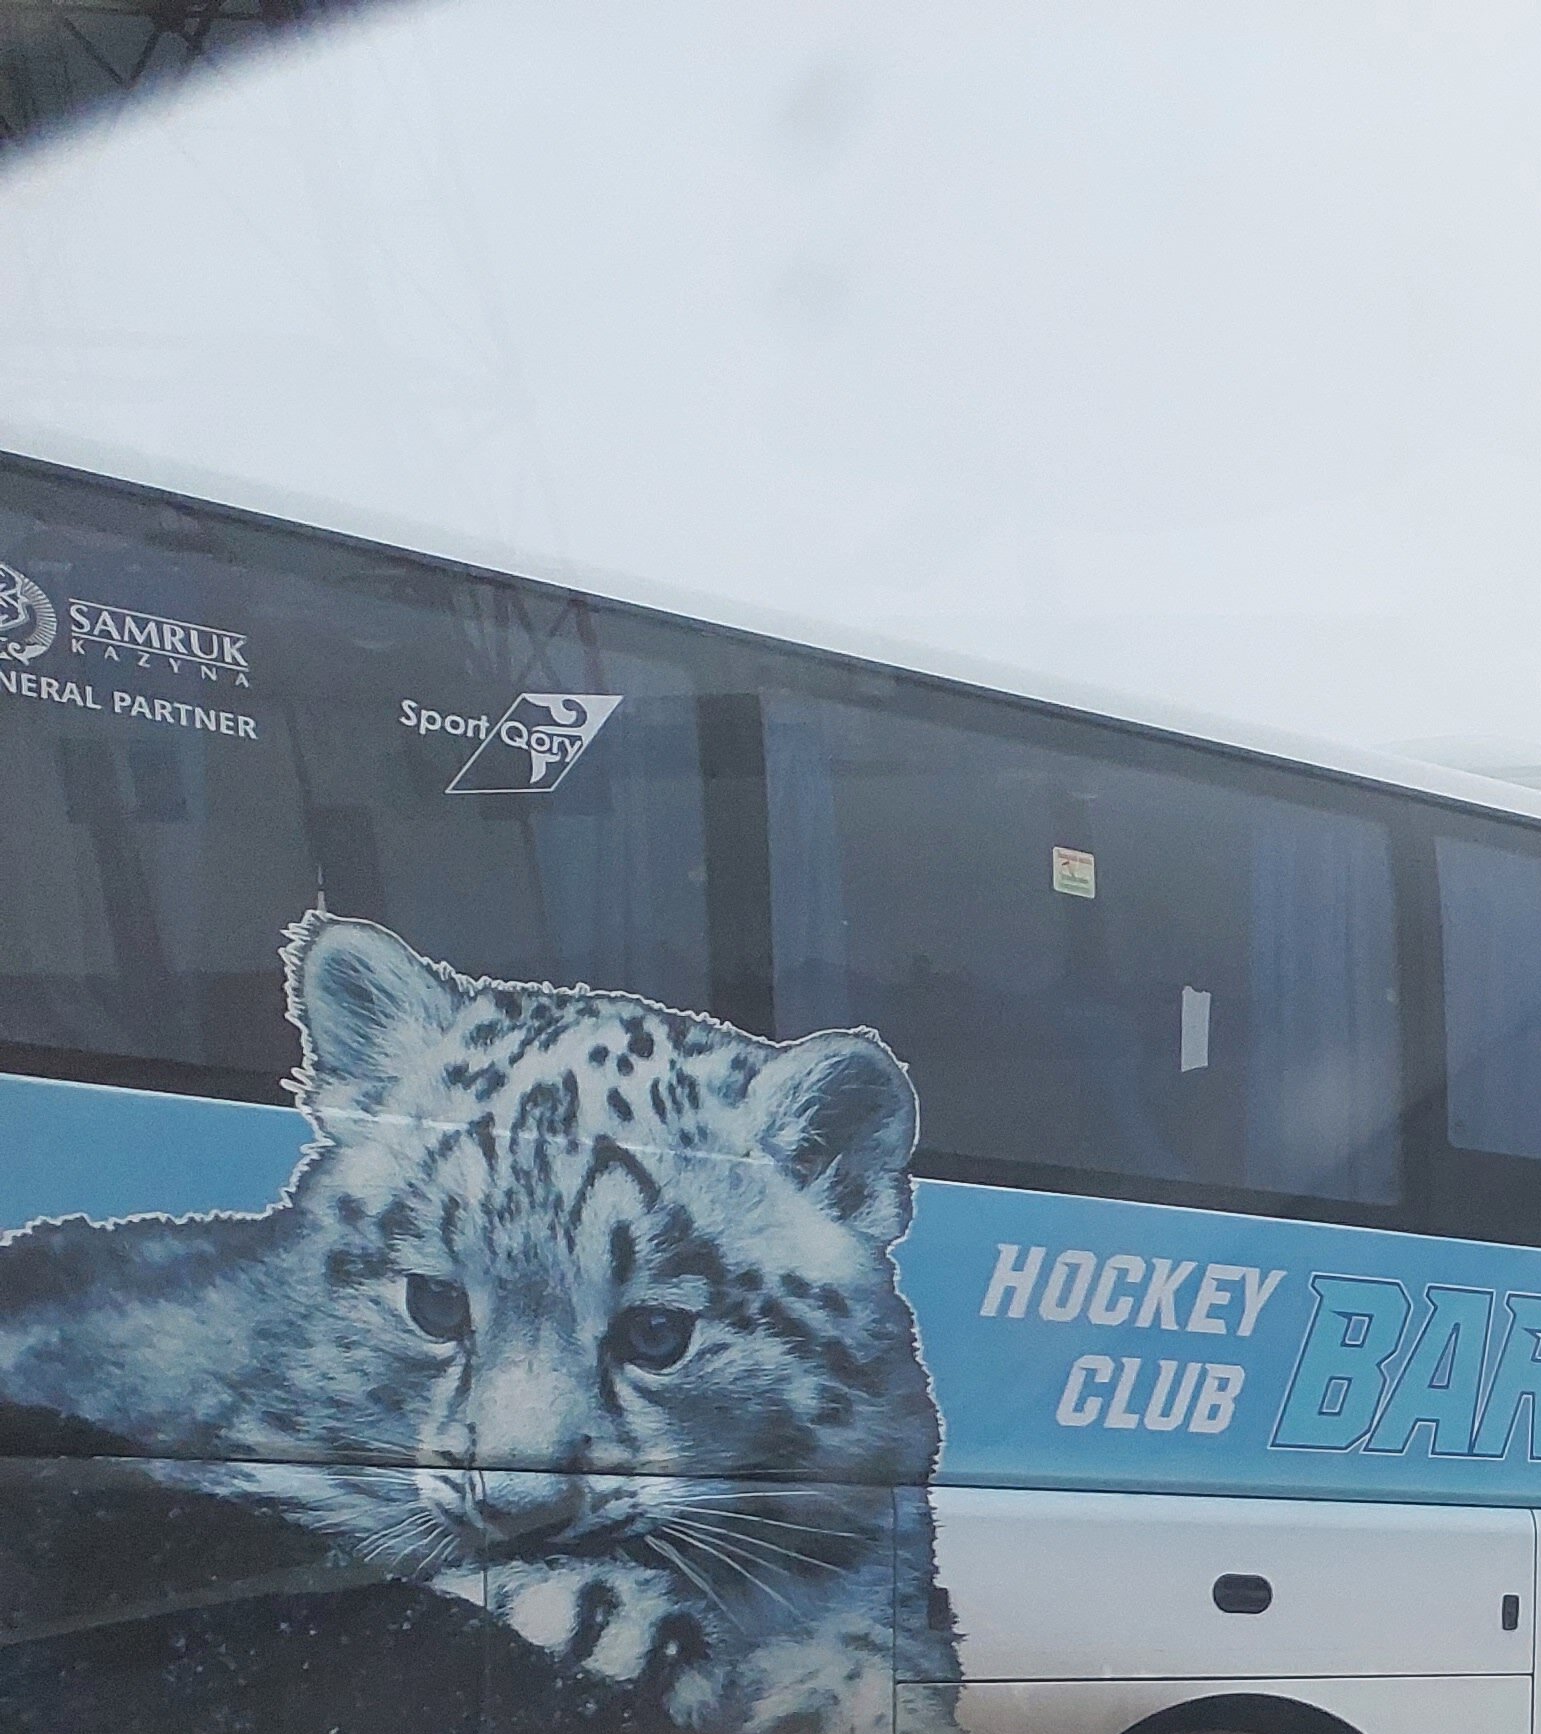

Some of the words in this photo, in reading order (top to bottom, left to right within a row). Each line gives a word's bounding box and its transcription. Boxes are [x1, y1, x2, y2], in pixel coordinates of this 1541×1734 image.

[69, 604, 249, 667] SAMRUK
[71, 638, 250, 688] KAZYNA
[112, 690, 259, 740] PARTNER
[399, 699, 490, 740] Sport
[500, 720, 582, 763] Qory
[978, 1242, 1289, 1338] HOCKEY
[1054, 1354, 1246, 1435] CLUB
